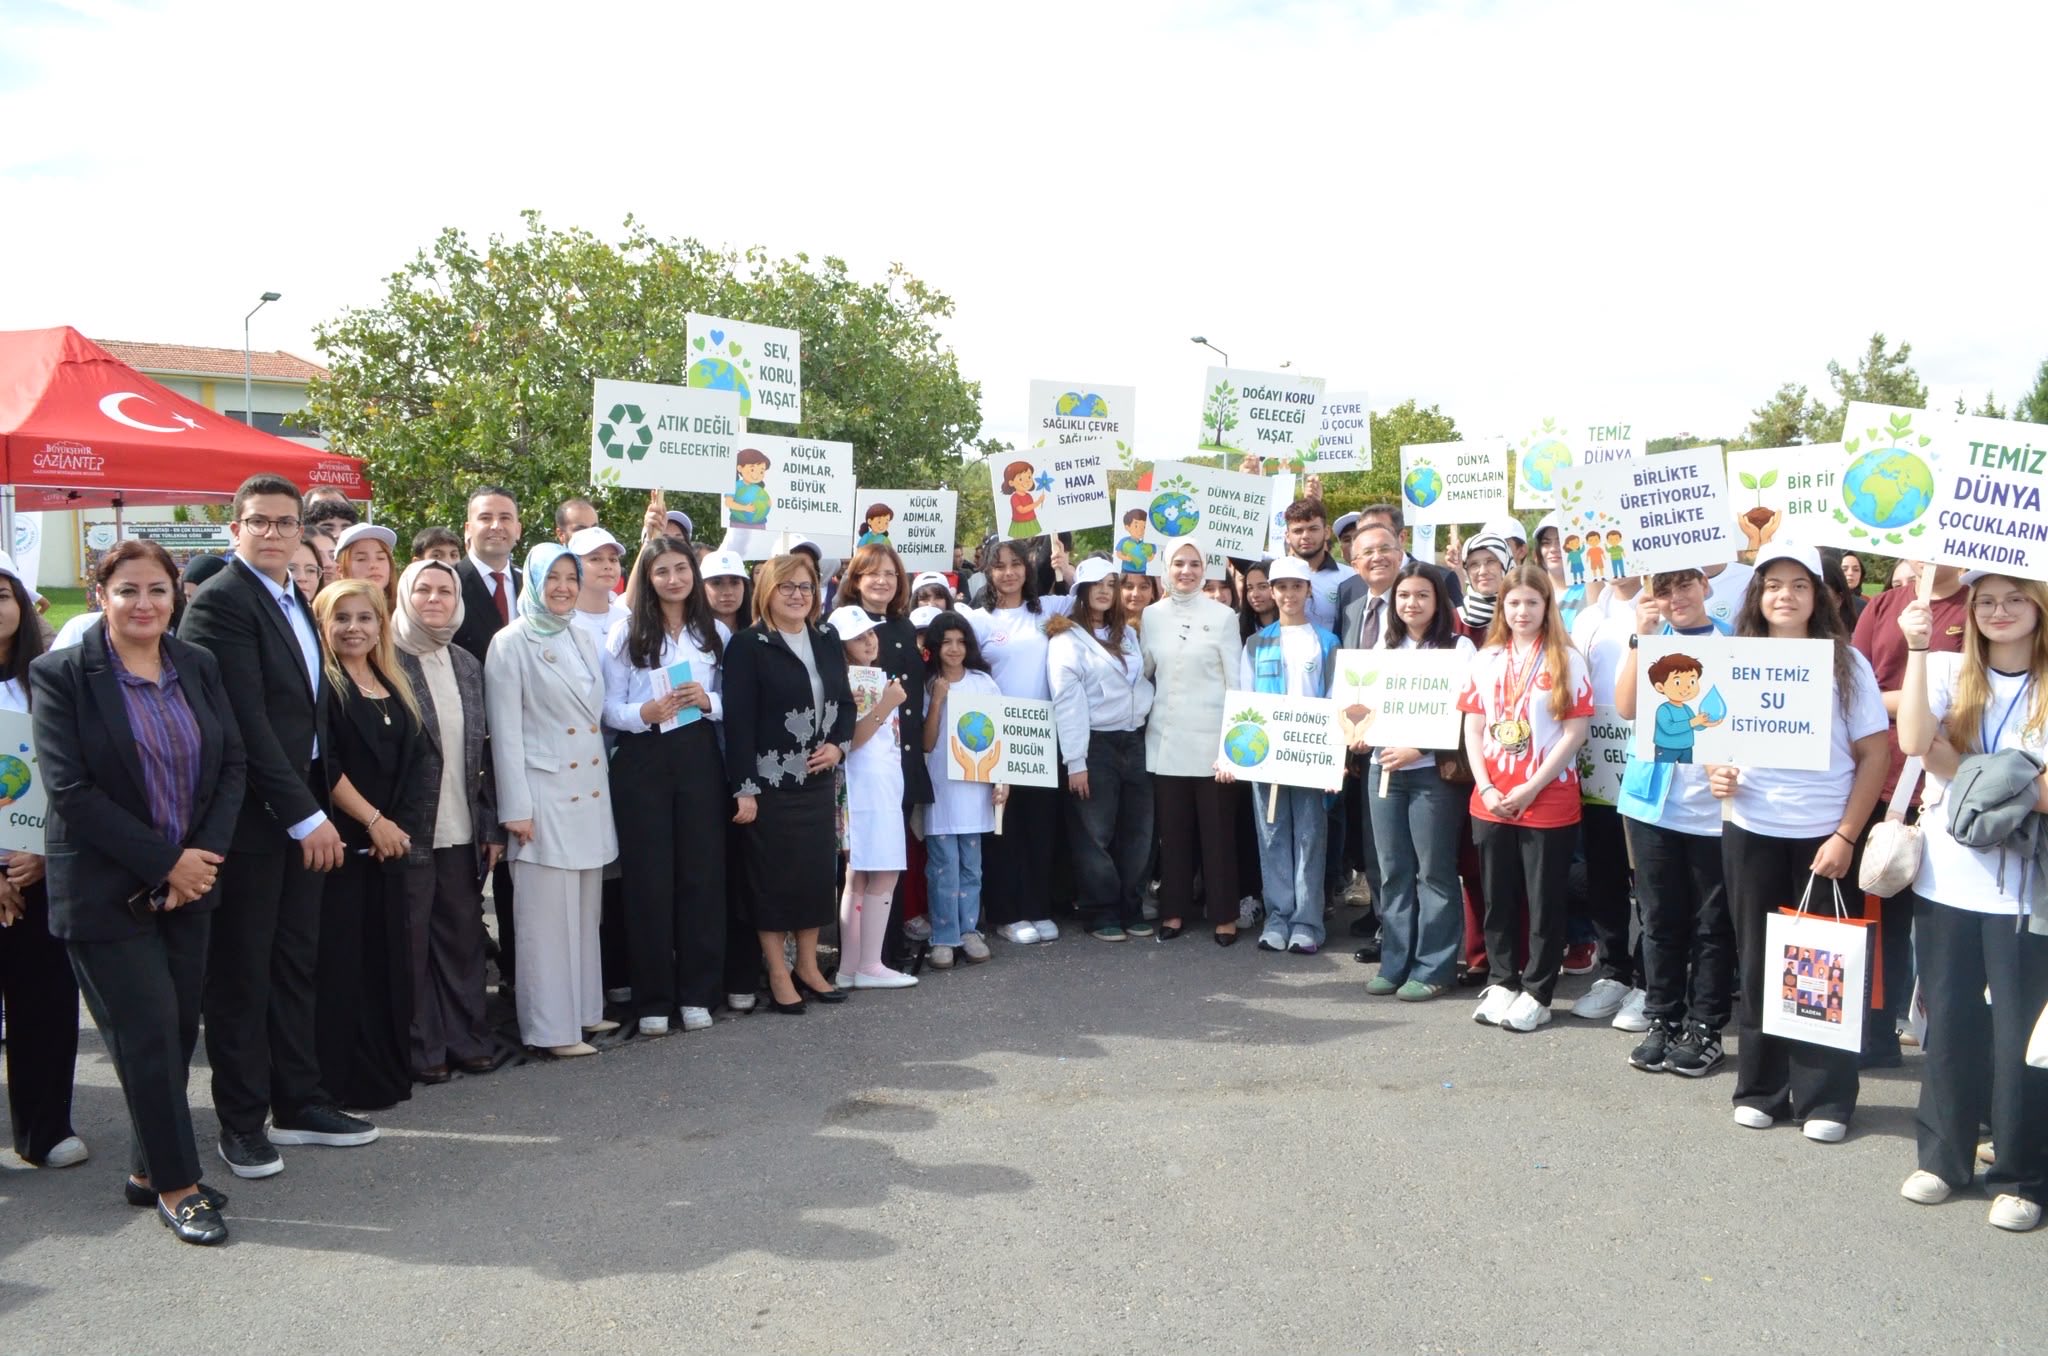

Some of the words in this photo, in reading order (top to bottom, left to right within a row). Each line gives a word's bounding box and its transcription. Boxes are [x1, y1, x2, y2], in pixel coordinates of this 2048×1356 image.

[764, 342, 790, 361] SEV,
[759, 365, 797, 387] KORU,
[758, 389, 798, 411] YAŞAT.
[1242, 384, 1282, 403] DOĞAYI
[1285, 390, 1315, 405] KORU
[1249, 406, 1305, 424] GELECEĞİ
[1330, 404, 1361, 416] ÇEVRE
[657, 415, 690, 432] ATIK
[694, 415, 734, 436] DEĞİL
[1043, 417, 1085, 430] SAĞLIKLI
[1088, 421, 1119, 432] ÇEVRE
[1332, 419, 1364, 431] ÇOCUK
[1588, 422, 1631, 441] TEMİZ
[1256, 428, 1294, 445] YAŞAT.
[1318, 433, 1352, 446] ÜVENLİ
[659, 441, 730, 458] GELECEKTİR!
[791, 446, 826, 460] KÜÇÜK
[1318, 450, 1356, 460] ELECEK.
[1585, 446, 1631, 464] DÜNYA
[1969, 441, 2047, 475] TEMİZ
[1055, 460, 1072, 471] BEN
[1075, 455, 1101, 469] TEMİZ
[1457, 453, 1490, 466] DÜNYA
[783, 463, 835, 479] ADIMLAR,
[1446, 471, 1504, 486] ÇOCUKLARIN
[1633, 465, 1698, 486] BİRLİKTE
[790, 478, 826, 494] BÜYÜK
[1065, 474, 1095, 489] HAVA
[1788, 471, 1811, 489] BİR
[1057, 491, 1107, 506] İSTİYORUM.
[1207, 487, 1240, 501] DÜNYA
[1243, 491, 1266, 506] BİZE
[1447, 487, 1505, 501] EMANETİDİR.
[1620, 484, 1716, 510] ÜRETİYORUZ,
[1954, 474, 2041, 512] DÜNYA
[777, 495, 842, 514] DEĞİŞİMLER.
[909, 497, 938, 508] KÜÇÜK
[1789, 497, 1812, 514] BİR
[902, 512, 943, 524] ADIMLAR,
[1209, 504, 1240, 520] DEĞİL,
[1243, 508, 1260, 522] BİZ
[1640, 507, 1704, 529] BİRLİKTE
[908, 526, 935, 538] BÜYÜK
[1208, 520, 1254, 537] DÜNYAYA
[1939, 510, 2048, 542] ÇOCUKLARIN
[1216, 537, 1244, 551] AİTİZ.
[1632, 526, 1726, 552] KORUYORUZ.
[897, 541, 947, 556] DEĞİŞİMLER.
[1944, 538, 2029, 567] HAKKIDIR.
[1732, 667, 1760, 681] BEN
[1766, 665, 1809, 682] TEMİZ
[1386, 673, 1407, 690] BİR
[1411, 674, 1452, 693] FİDAN,
[1383, 698, 1404, 714] BİR
[1409, 701, 1449, 715] UMUT.
[1760, 692, 1785, 709] SU
[1004, 706, 1048, 721] GELECEĞİ
[1272, 710, 1293, 722] GERİ
[1296, 711, 1328, 727] DÖNÜŞ
[1003, 725, 1051, 739] KORUMAK
[1590, 722, 1631, 740] DOĞAYI
[1732, 716, 1815, 735] İSTİYORUM.
[1010, 743, 1044, 756] BUGÜN
[1276, 748, 1335, 766] DÖNÜŞTÜR.
[1007, 761, 1048, 775] BAŞLAR.
[9, 812, 46, 828] ÇOCU
